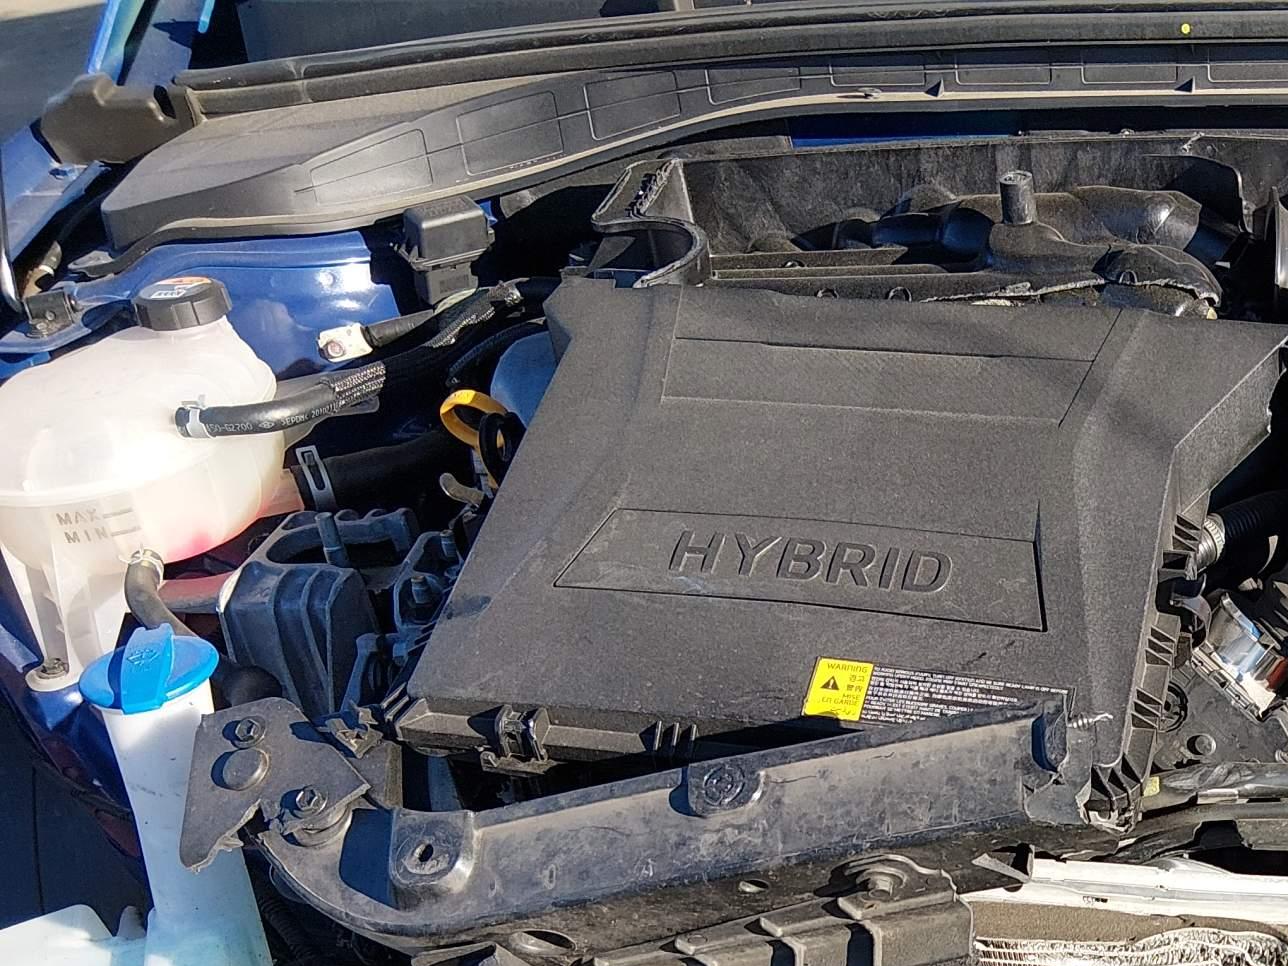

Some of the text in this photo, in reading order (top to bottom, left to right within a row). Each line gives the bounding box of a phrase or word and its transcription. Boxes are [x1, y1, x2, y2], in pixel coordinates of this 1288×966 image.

[56, 508, 100, 526] MAX
[64, 526, 108, 544] MIN
[668, 530, 952, 595] HYBRID
